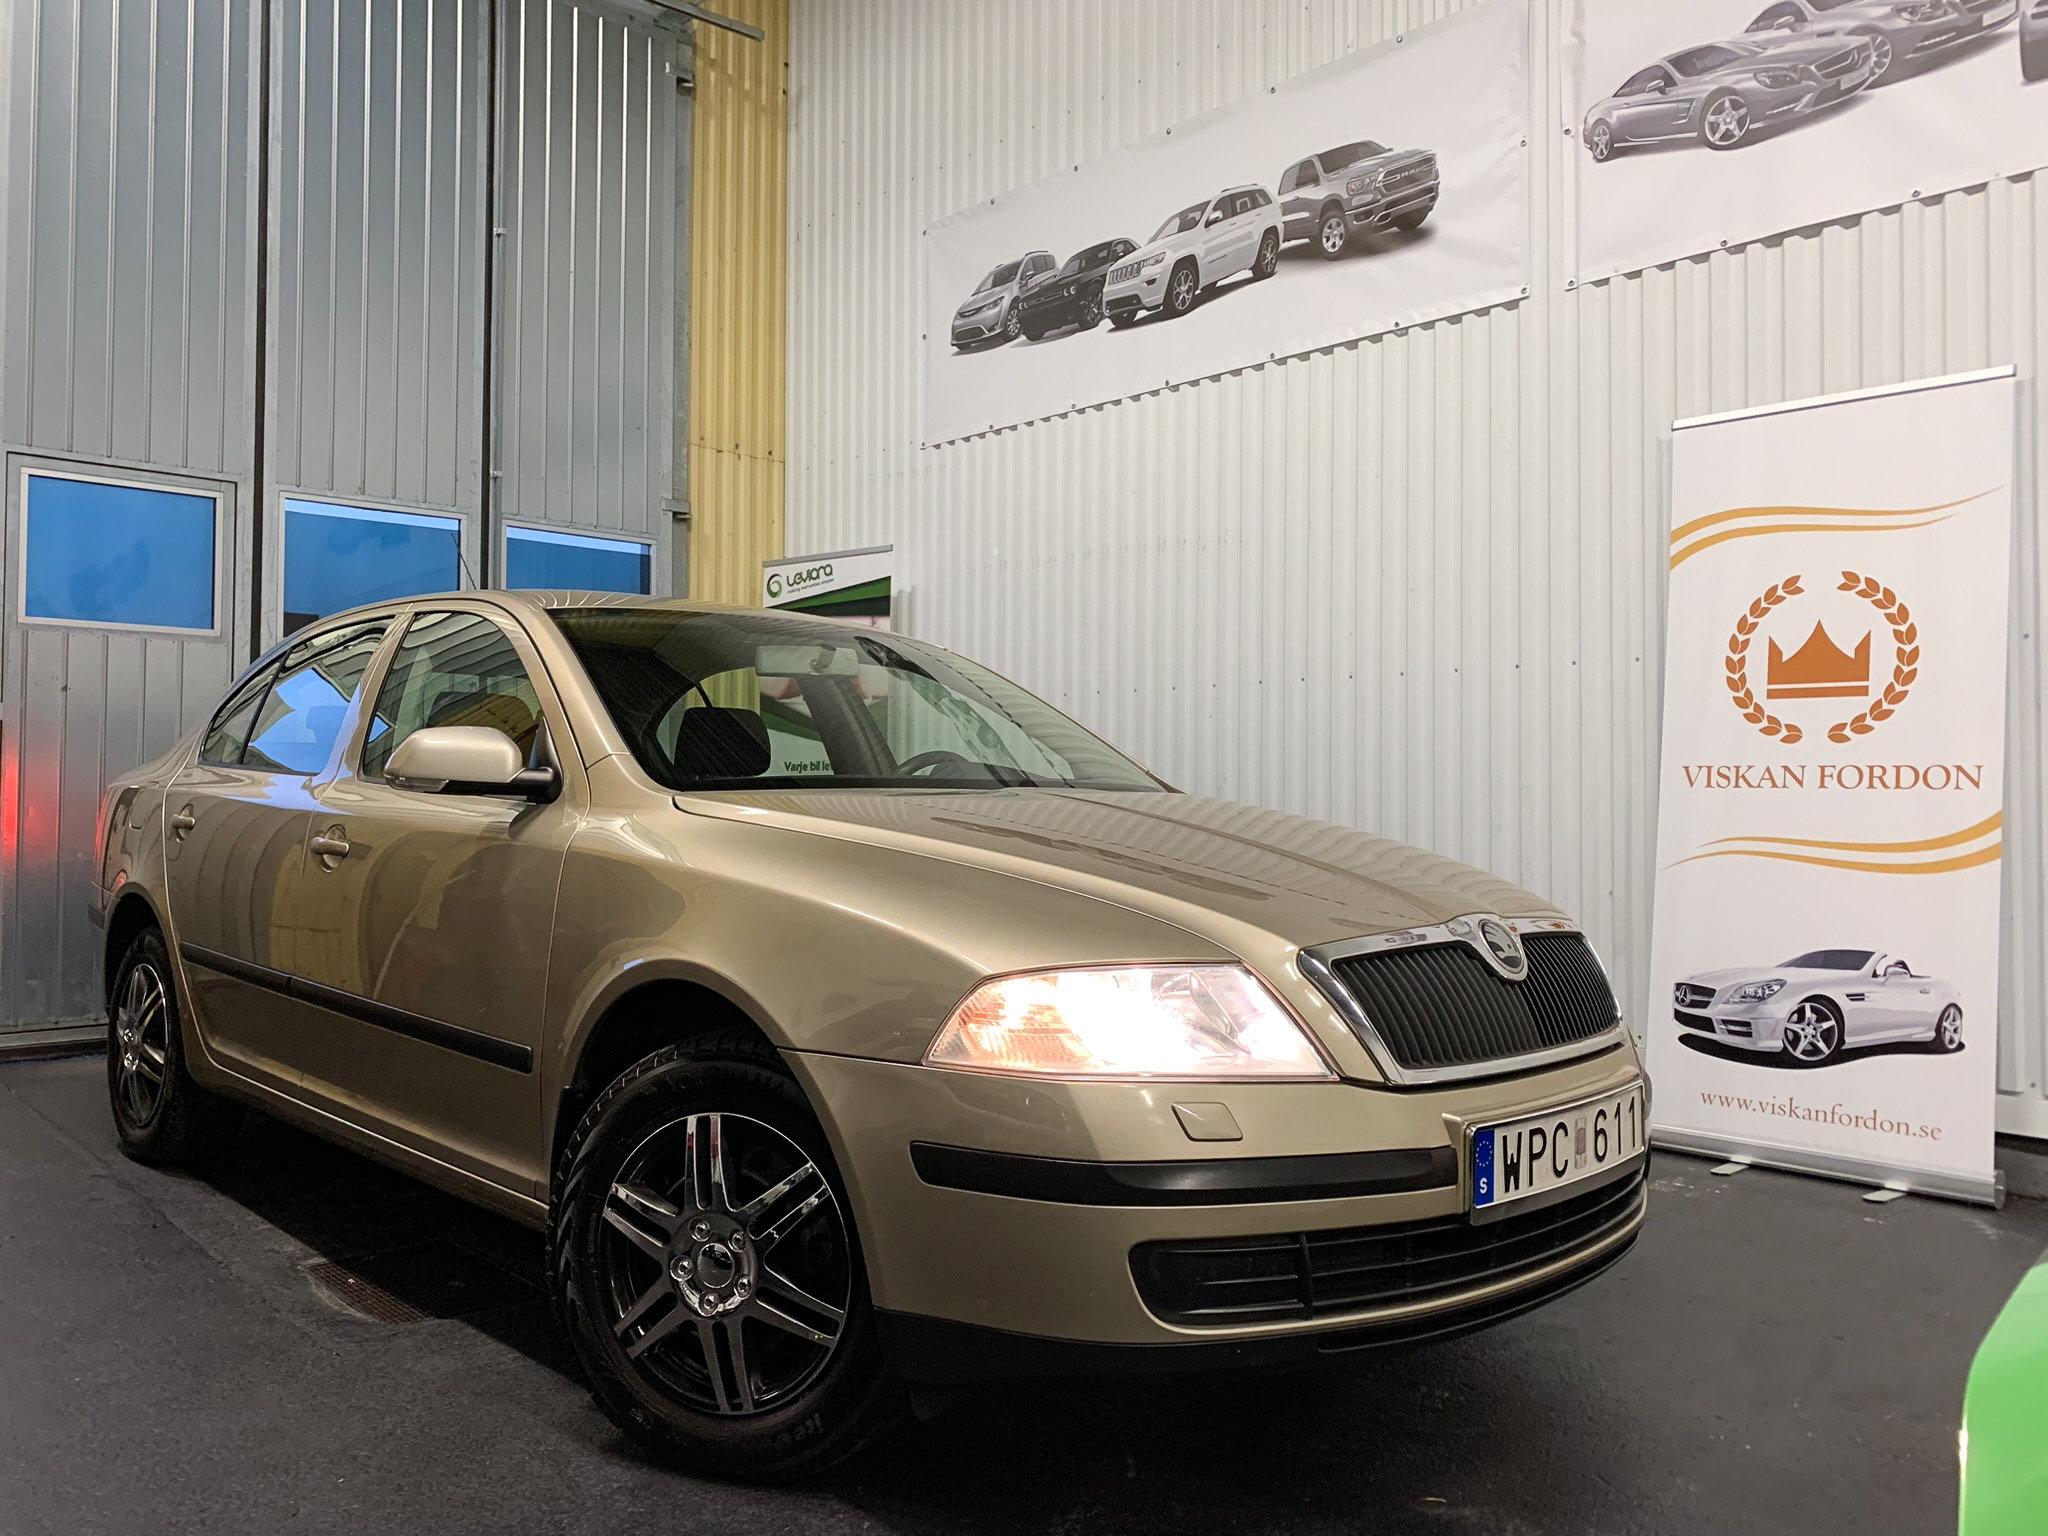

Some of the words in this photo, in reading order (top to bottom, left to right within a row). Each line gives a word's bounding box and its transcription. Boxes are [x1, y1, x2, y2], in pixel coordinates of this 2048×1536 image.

[784, 761, 808, 774] Varje
[810, 760, 821, 771] bil
[822, 760, 831, 771] le
[1682, 764, 1807, 789] VISKAN
[1817, 763, 1984, 791] FORDON
[1700, 1091, 1943, 1141] www.viskanfordon.se
[1479, 1177, 1488, 1194] S
[1502, 1121, 1569, 1193] WPC
[1594, 1096, 1636, 1162] 611
